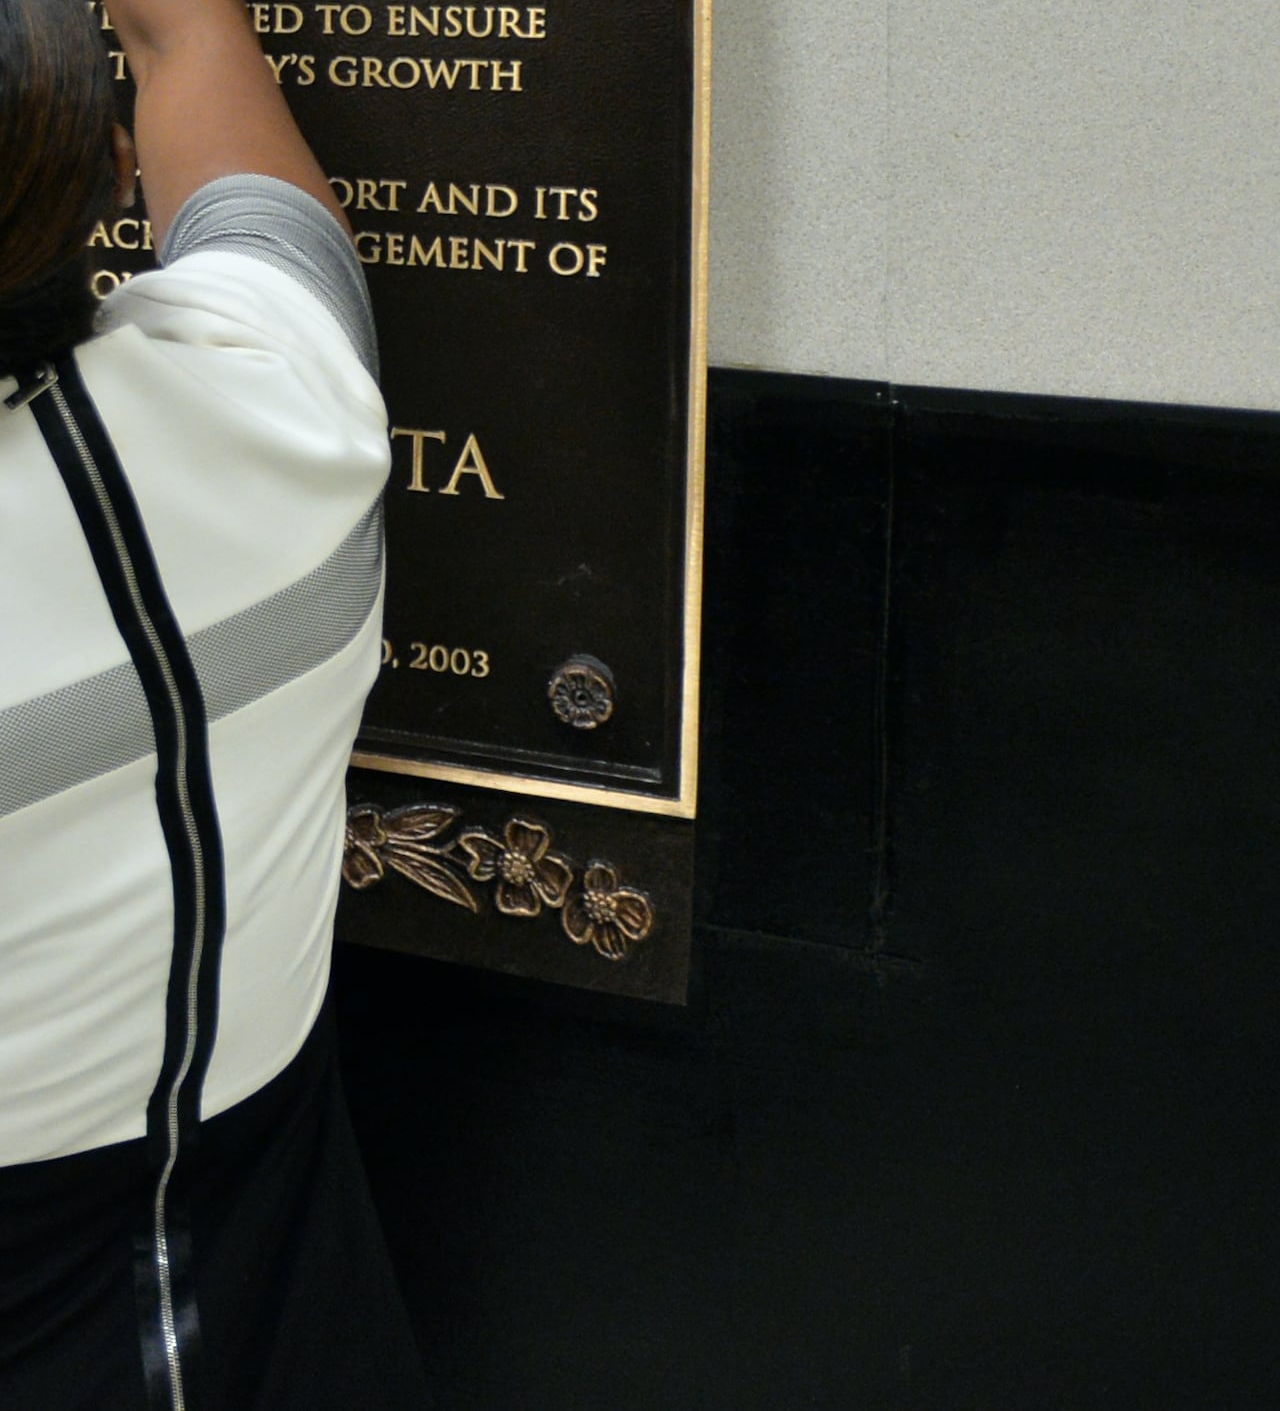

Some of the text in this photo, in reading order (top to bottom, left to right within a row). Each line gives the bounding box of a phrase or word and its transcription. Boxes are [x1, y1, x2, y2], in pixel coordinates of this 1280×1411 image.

[315, 4, 373, 36] TO
[387, 5, 547, 39] ENSURE
[328, 55, 523, 92] GROWTH
[416, 180, 519, 218] AND
[534, 186, 599, 222] ITS
[548, 242, 608, 278] OF
[409, 641, 490, 678] 2003
